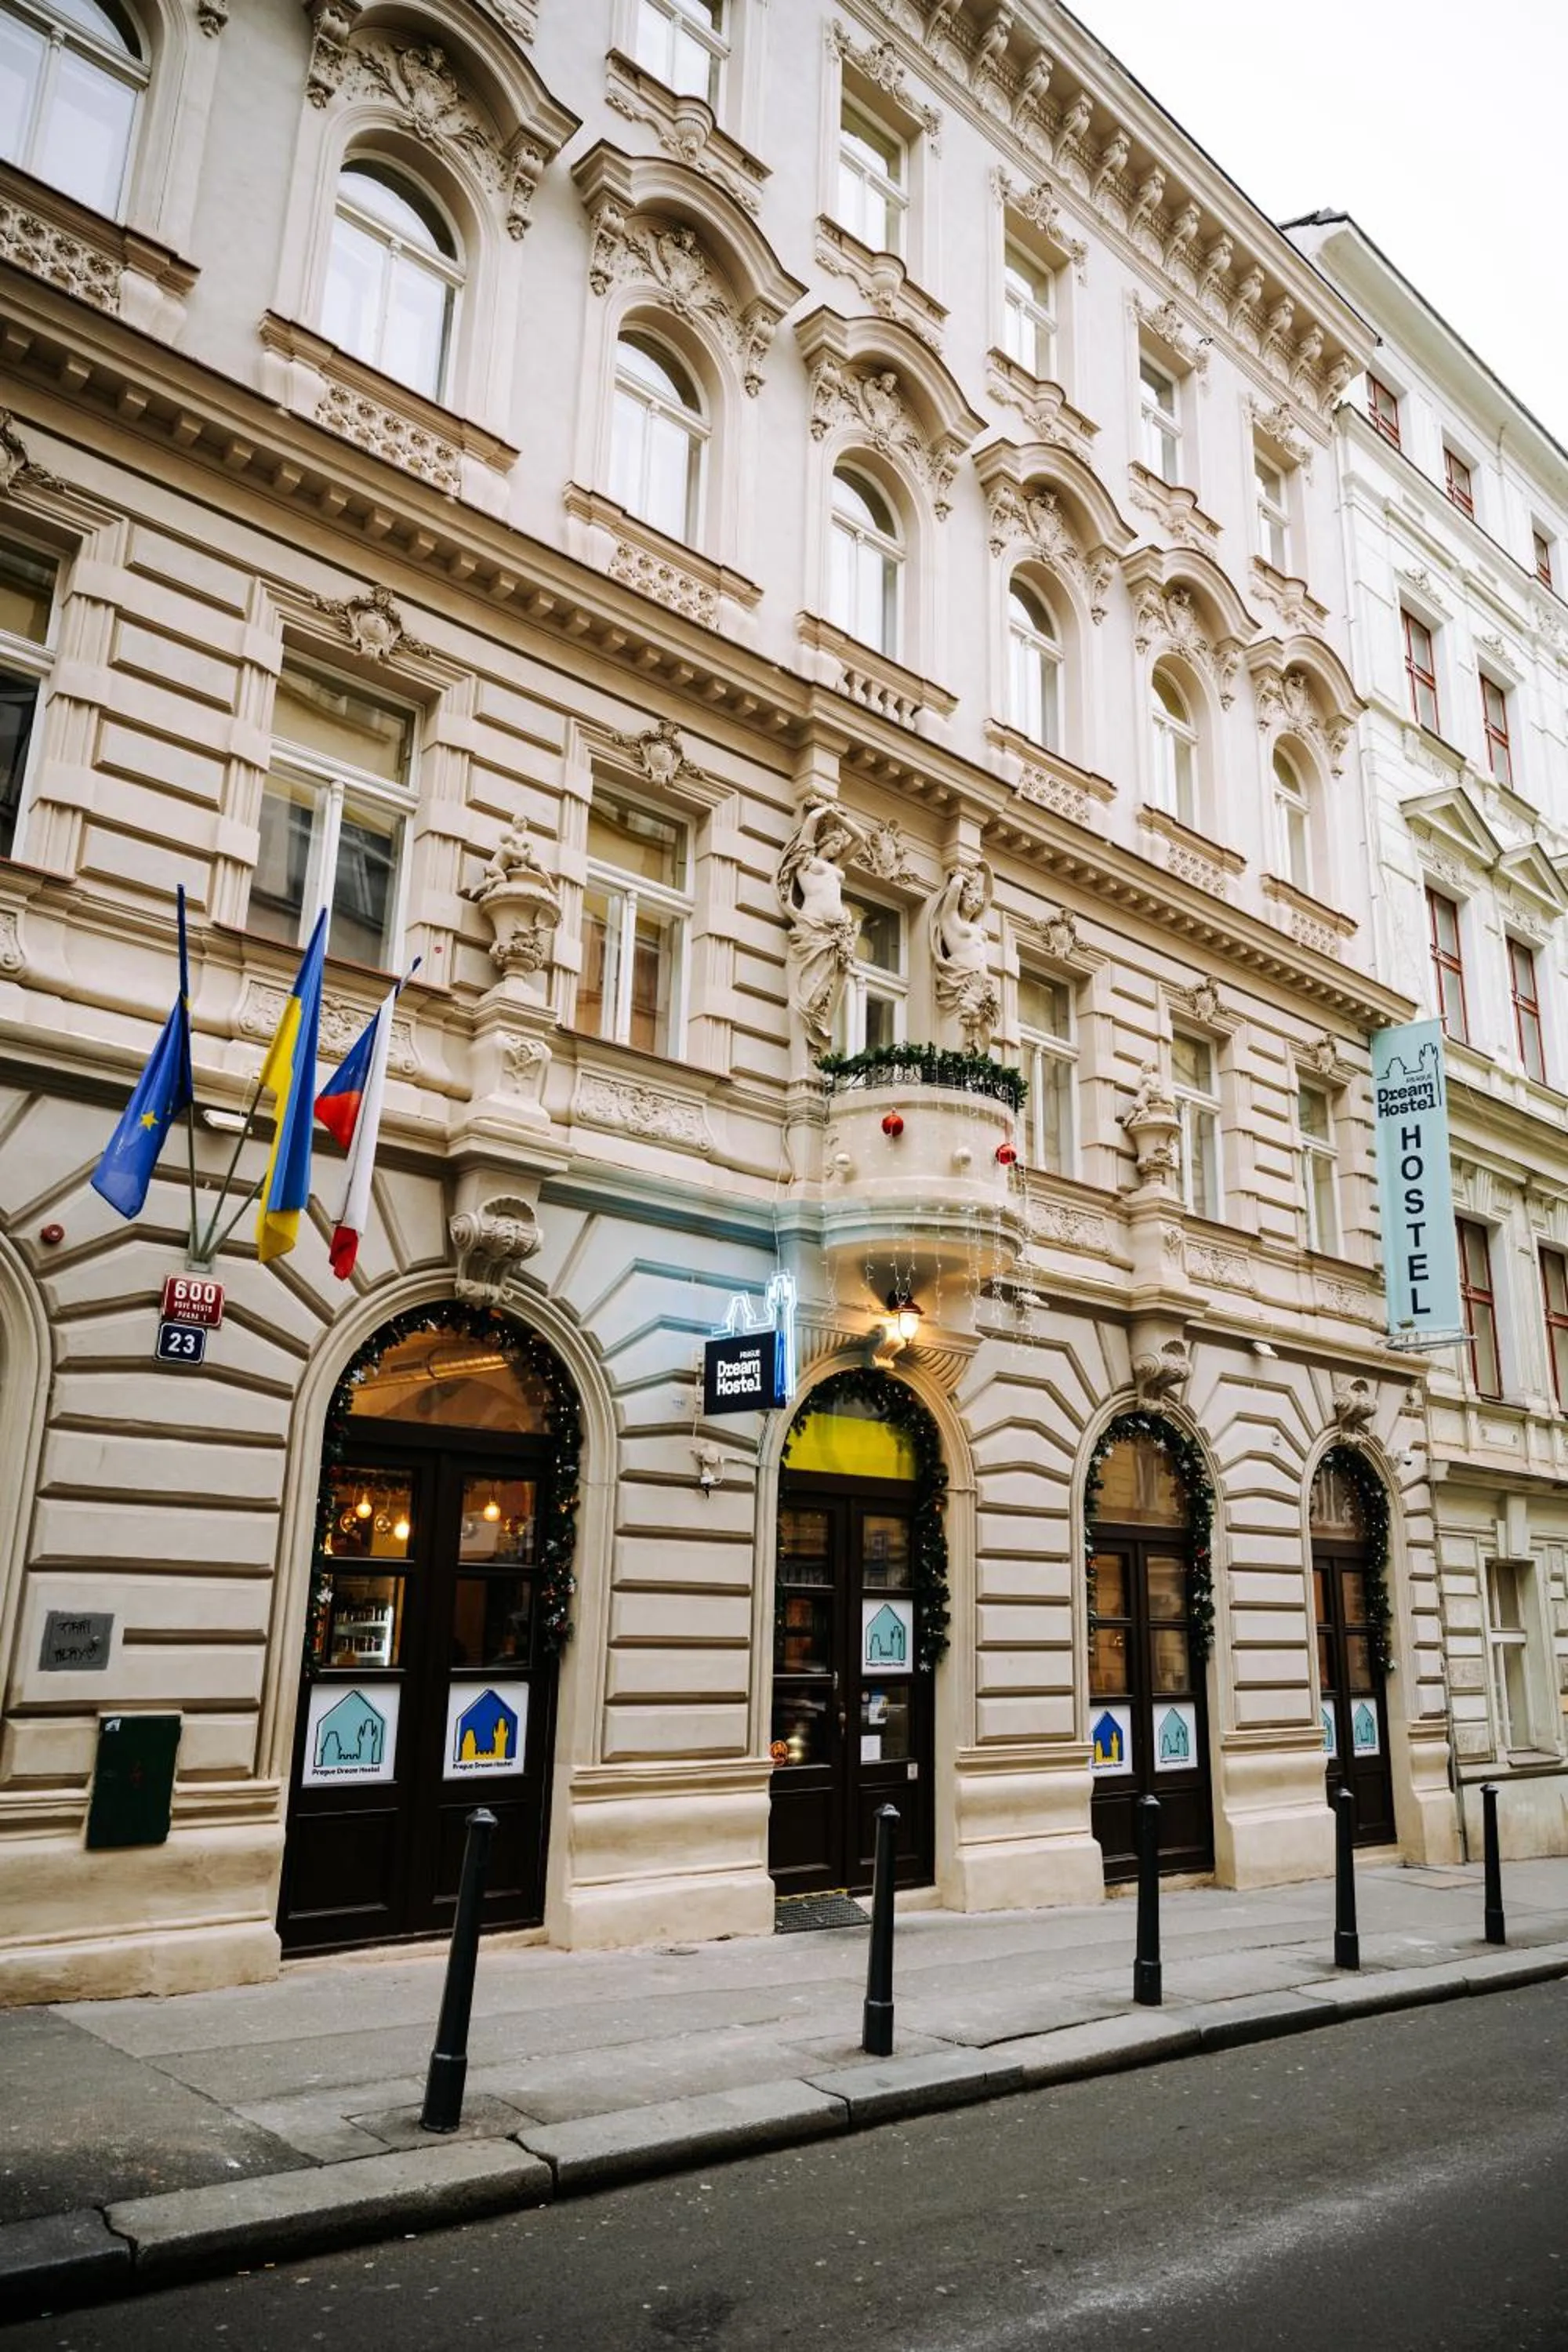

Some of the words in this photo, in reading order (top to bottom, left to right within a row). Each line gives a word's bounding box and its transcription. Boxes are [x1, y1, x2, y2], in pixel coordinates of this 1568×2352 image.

[1377, 1082, 1434, 1103] Dream
[1378, 1094, 1436, 1118] Hostel
[1400, 1123, 1431, 1315] HOSTEL
[174, 1280, 216, 1304] 600
[167, 1332, 195, 1354] 23
[717, 1359, 761, 1378] Dream
[717, 1373, 761, 1396] Hostel
